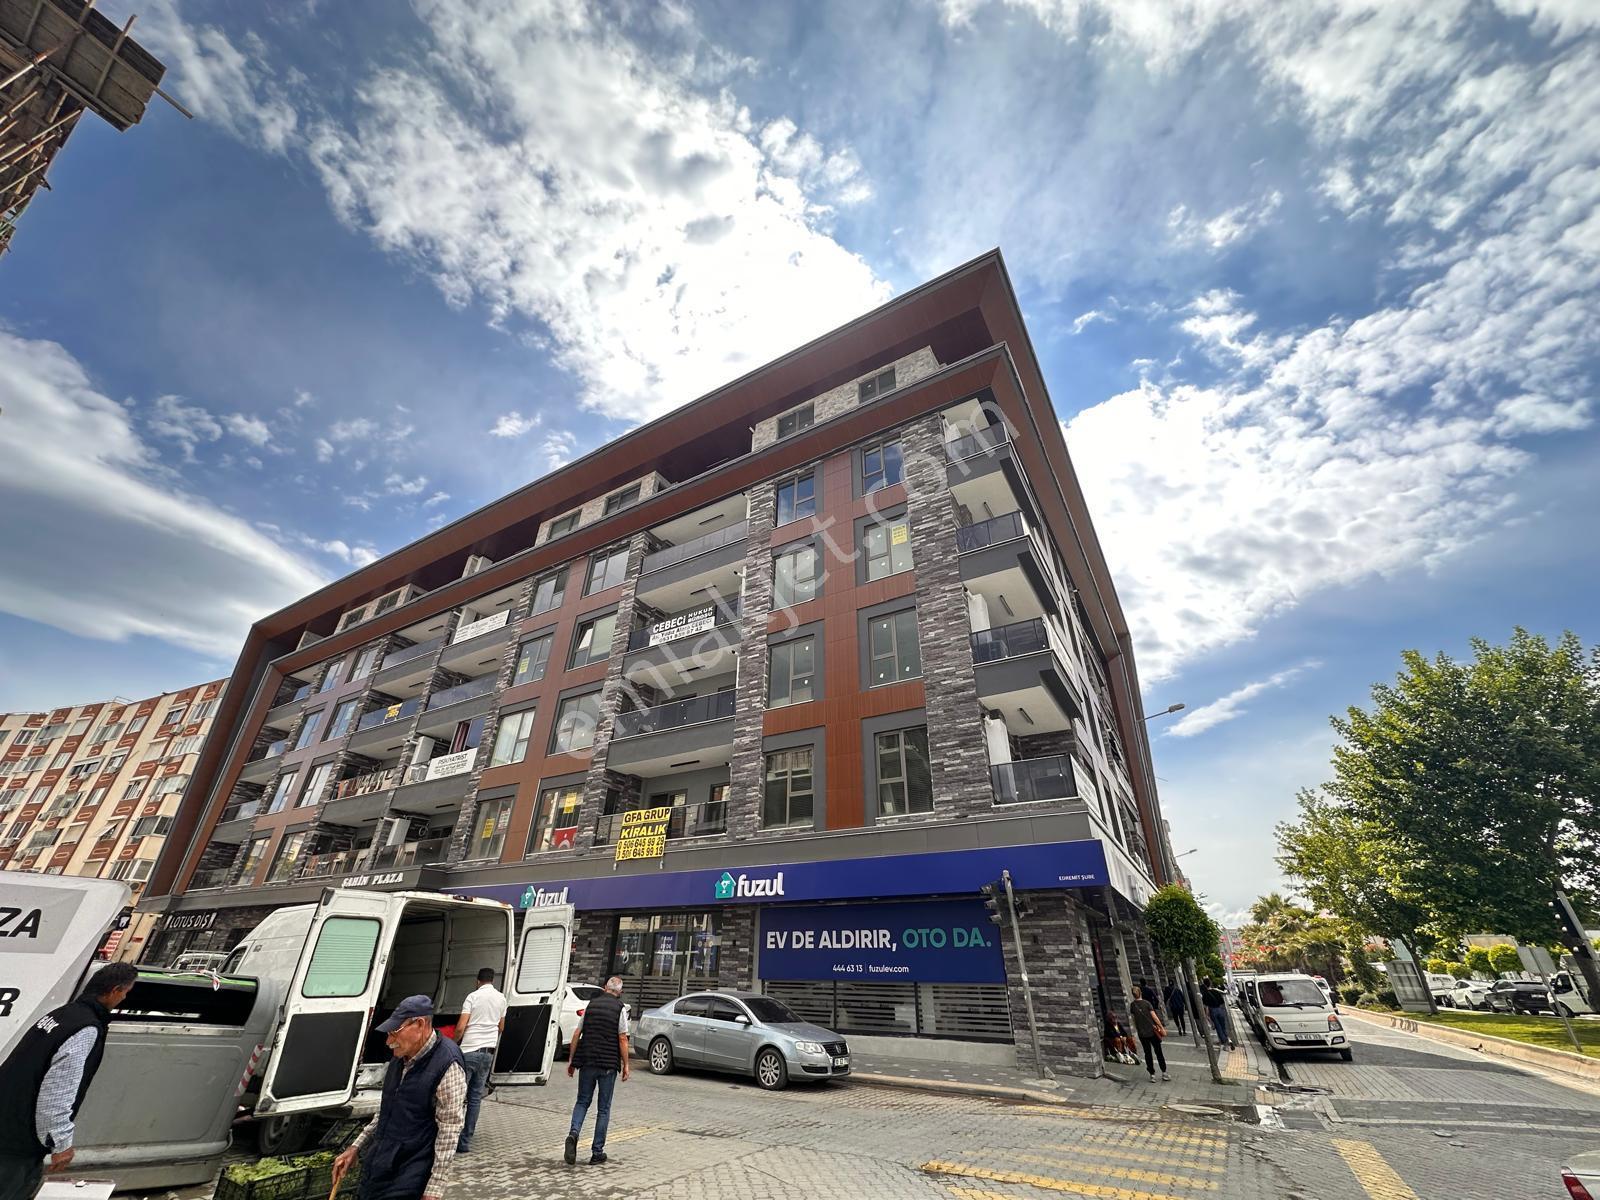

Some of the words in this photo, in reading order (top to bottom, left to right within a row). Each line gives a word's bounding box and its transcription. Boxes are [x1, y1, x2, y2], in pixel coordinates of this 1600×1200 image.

[624, 812, 642, 823] GFA
[644, 807, 670, 820] GRUP
[620, 824, 666, 838] KİRALIK
[655, 846, 663, 856] 19
[342, 874, 370, 888] ŞAHİN
[372, 872, 404, 885] PLAZA
[736, 872, 785, 897] fuzul
[535, 886, 569, 906] fuzul
[169, 915, 195, 928] LOTUS
[193, 912, 210, 929] DİŞ
[766, 930, 788, 949] EV
[791, 930, 814, 949] DE
[818, 929, 897, 952] ALDIRIR,
[902, 928, 947, 948] OTO
[952, 927, 992, 948] DA.
[832, 964, 846, 972] 444
[846, 964, 855, 972] 63
[855, 964, 863, 972] 13
[868, 964, 910, 973] fuzulev.com
